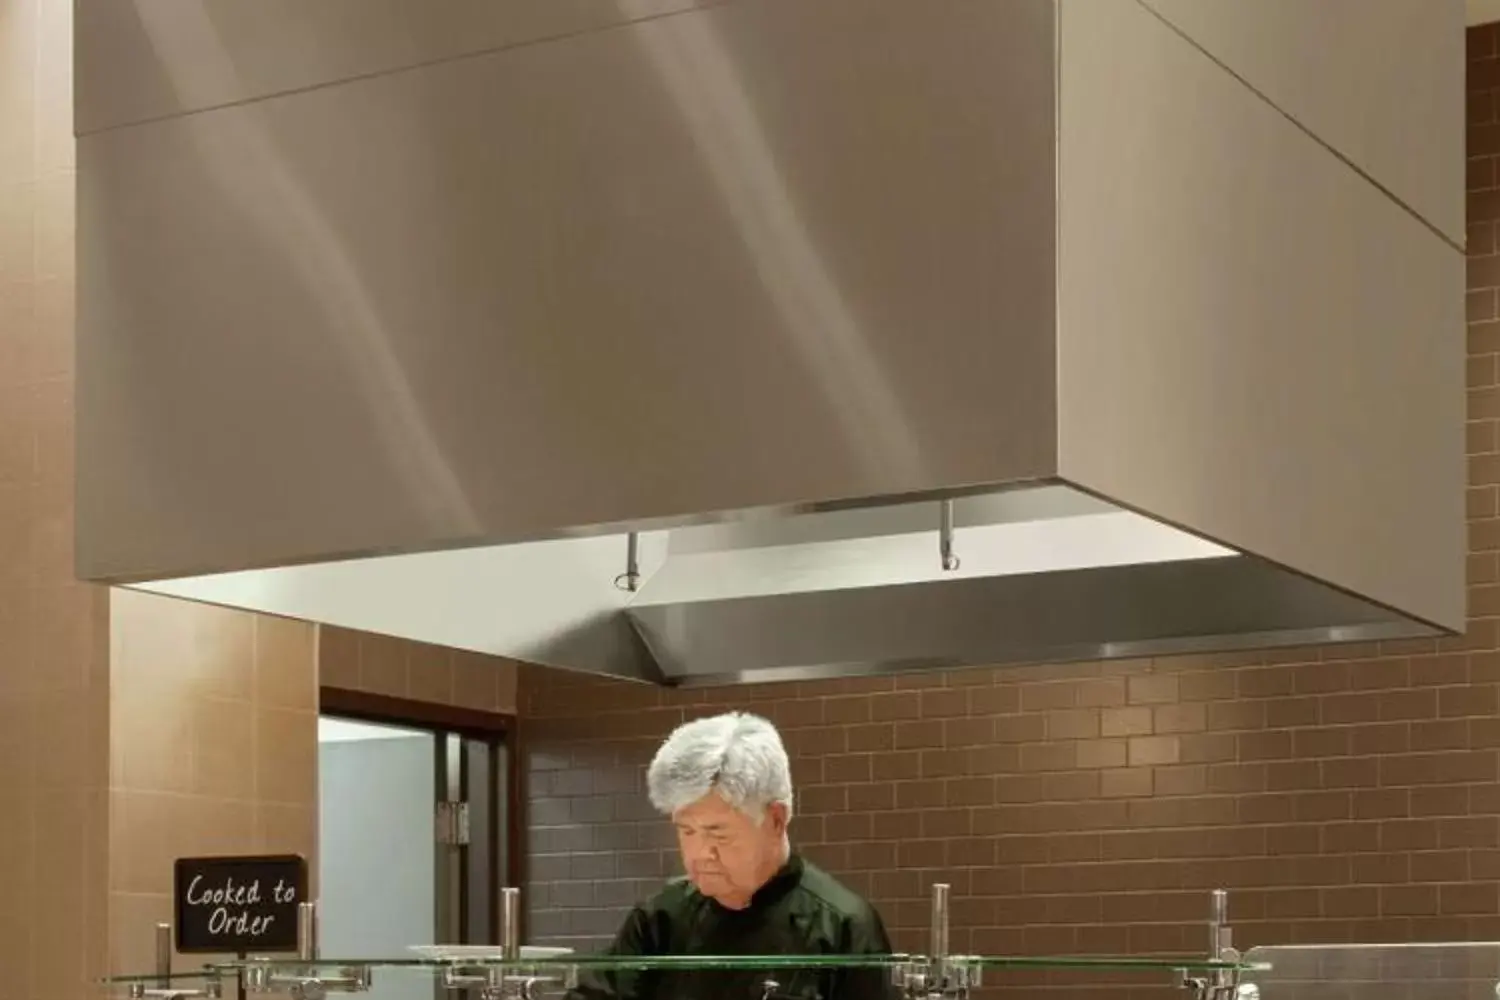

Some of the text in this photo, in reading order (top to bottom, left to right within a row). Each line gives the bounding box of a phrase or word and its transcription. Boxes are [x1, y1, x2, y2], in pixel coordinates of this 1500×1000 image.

[187, 875, 295, 905] Cooked to
[208, 907, 275, 935] Order
